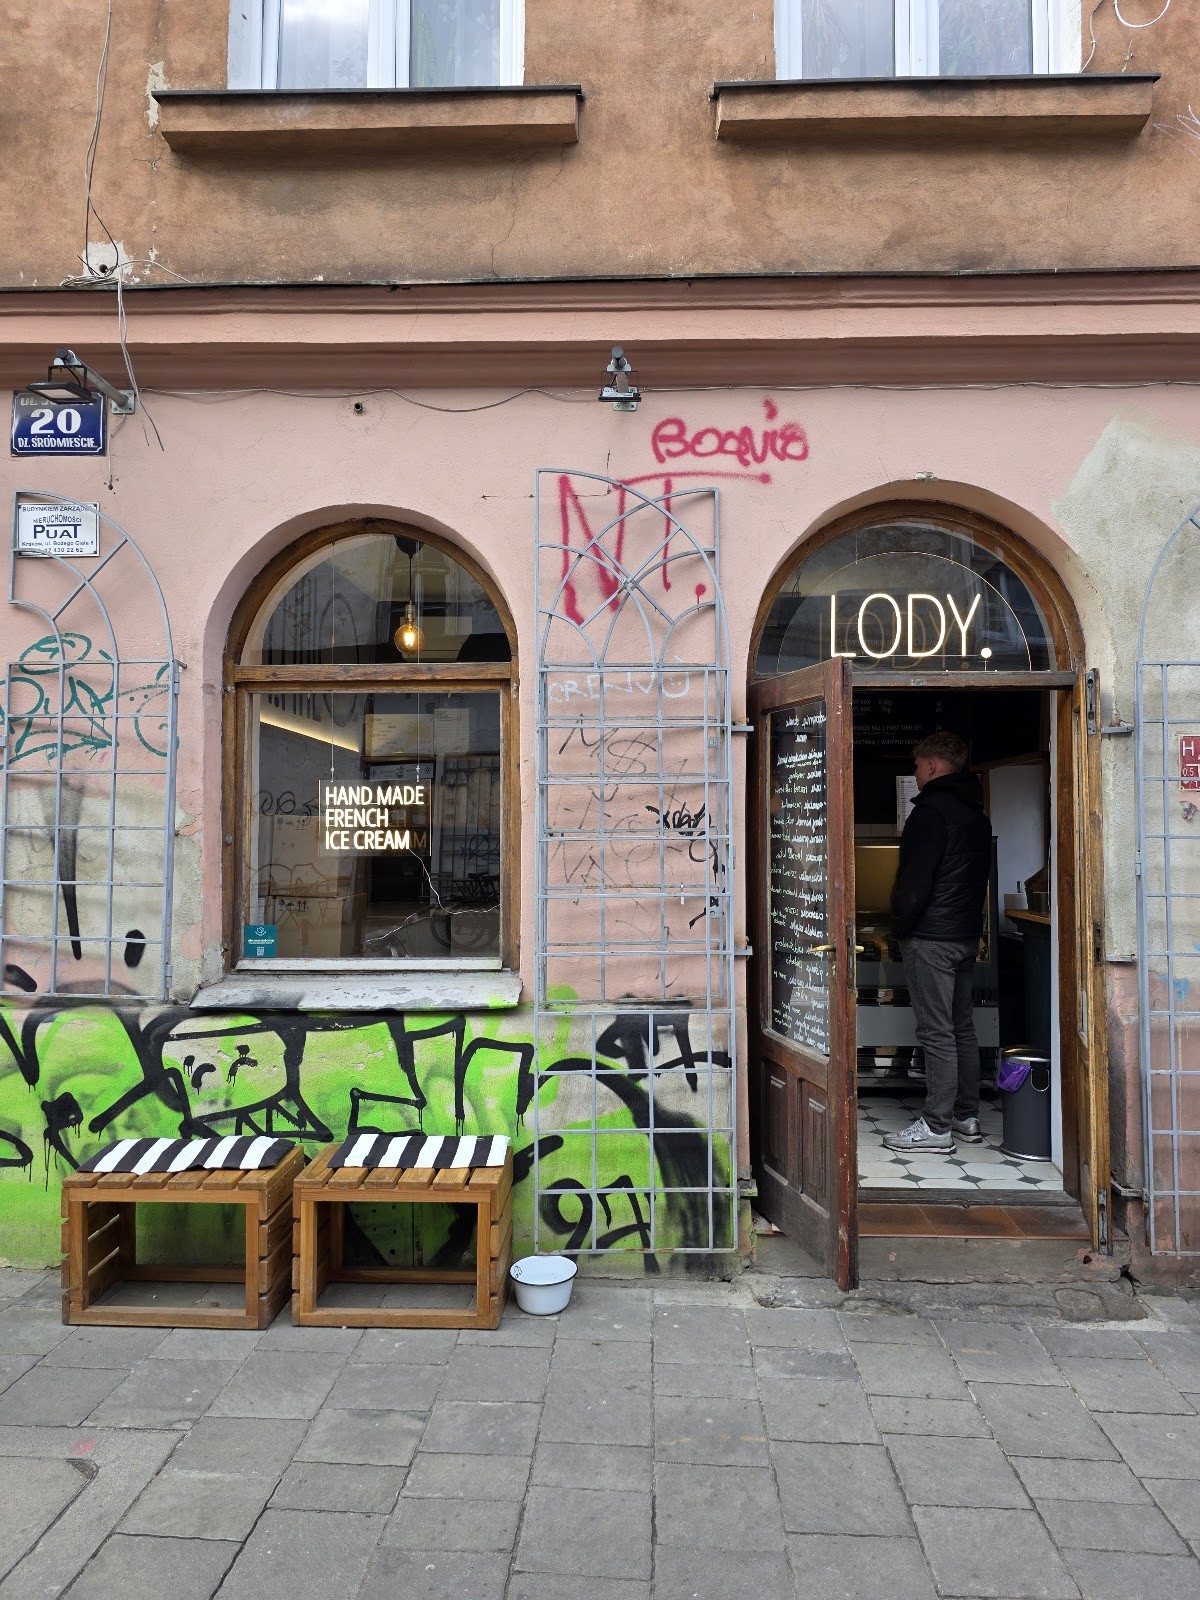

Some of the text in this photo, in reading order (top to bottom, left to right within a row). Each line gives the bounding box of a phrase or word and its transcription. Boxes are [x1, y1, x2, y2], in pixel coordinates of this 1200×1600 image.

[30, 408, 82, 435] 20
[17, 437, 31, 448] DZ.
[1182, 767, 1195, 777] 0.5
[325, 785, 425, 806] HAND MADE
[325, 807, 389, 828] FRENCH
[325, 829, 410, 850] ICE CREAM
